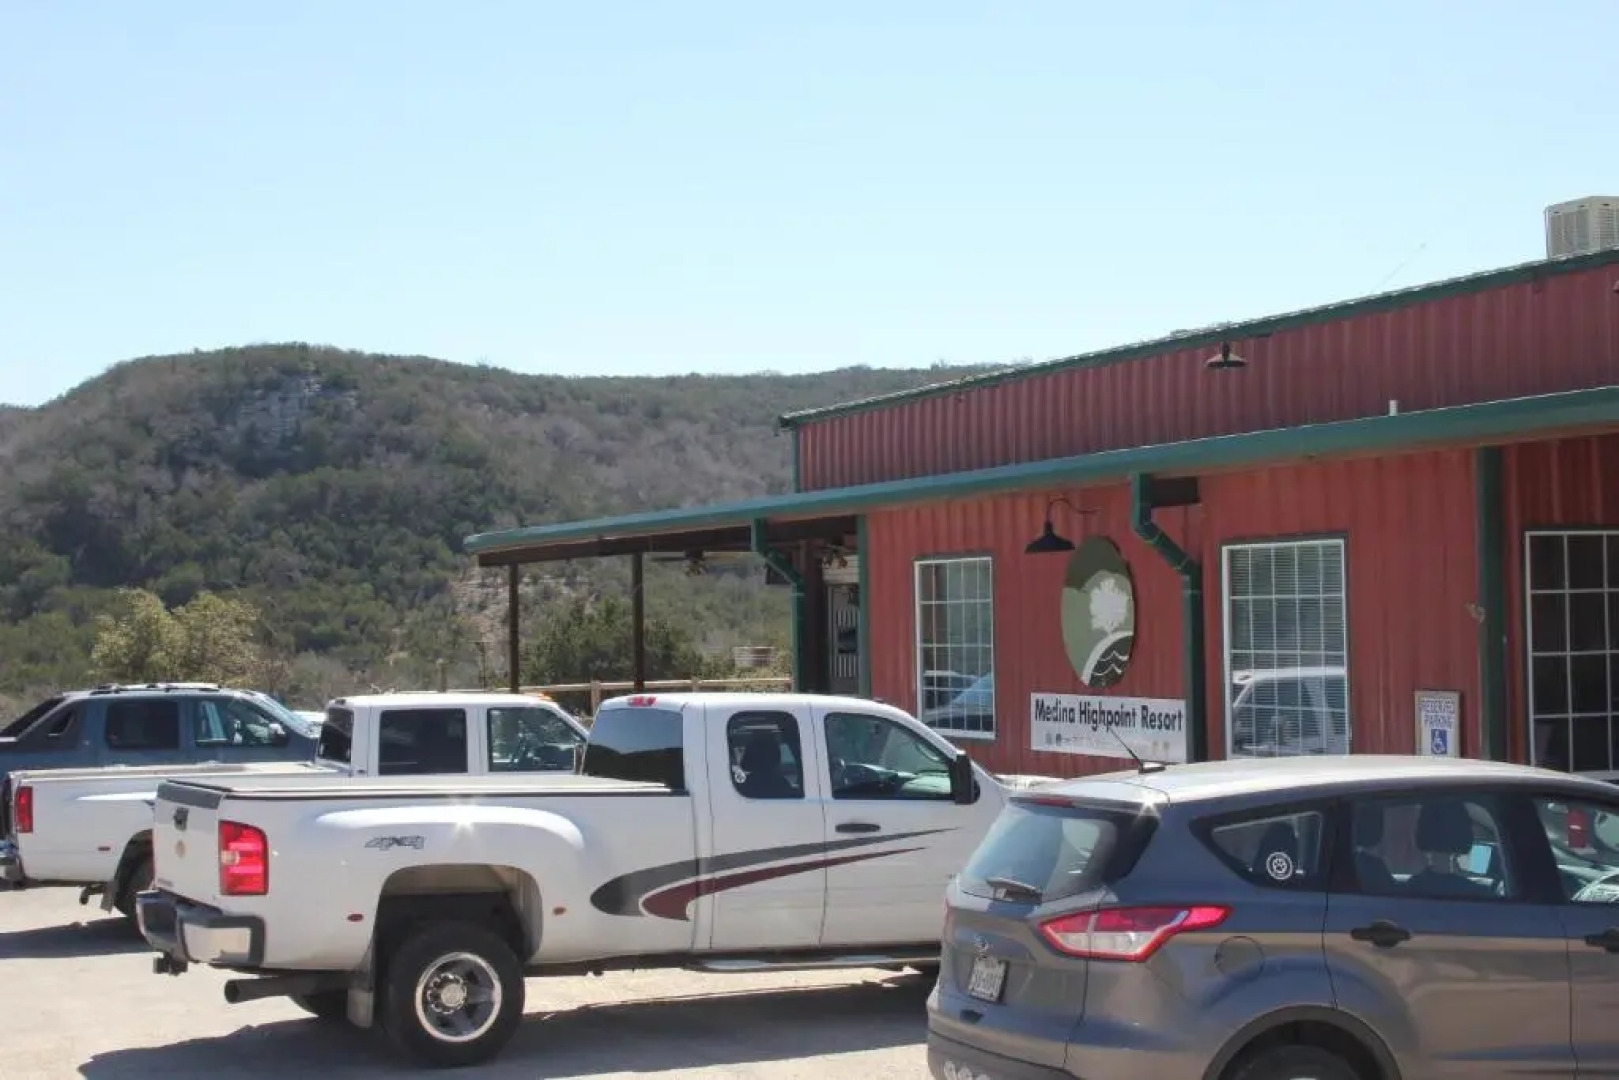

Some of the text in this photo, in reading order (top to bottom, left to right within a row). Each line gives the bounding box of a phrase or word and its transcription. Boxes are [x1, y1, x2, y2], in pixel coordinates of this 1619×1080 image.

[1035, 698, 1183, 731] Medina Highpoint Resort
